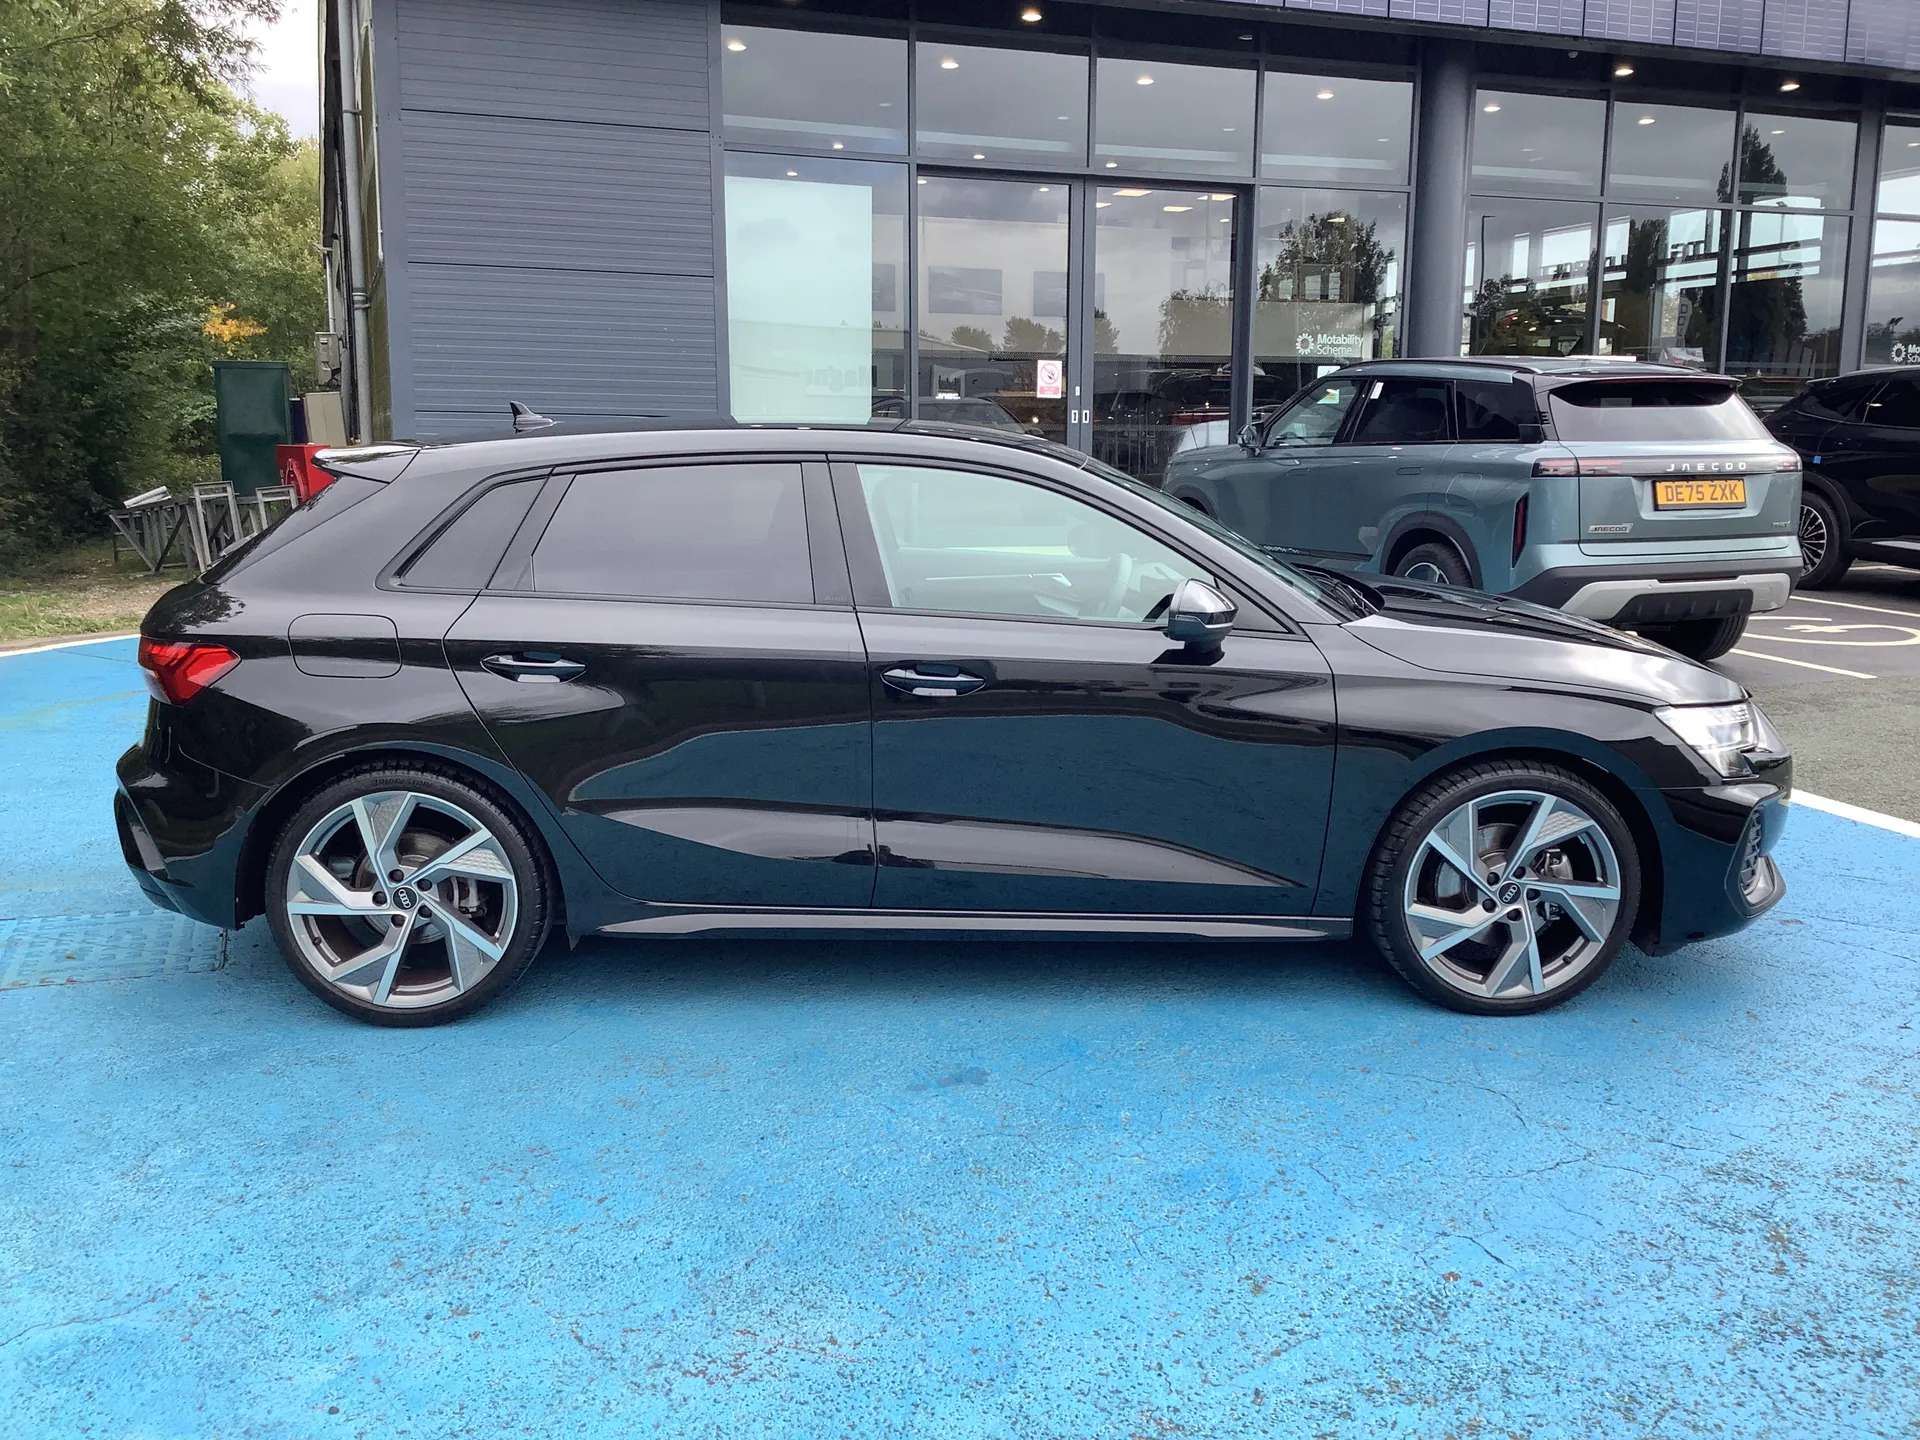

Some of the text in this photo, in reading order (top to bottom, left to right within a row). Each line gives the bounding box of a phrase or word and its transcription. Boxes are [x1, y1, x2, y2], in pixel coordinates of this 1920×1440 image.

[1317, 333, 1364, 348] Motability
[1317, 345, 1352, 355] Scheme
[1666, 462, 1747, 472] JAECOO
[1664, 483, 1740, 502] DE75 ZXK
